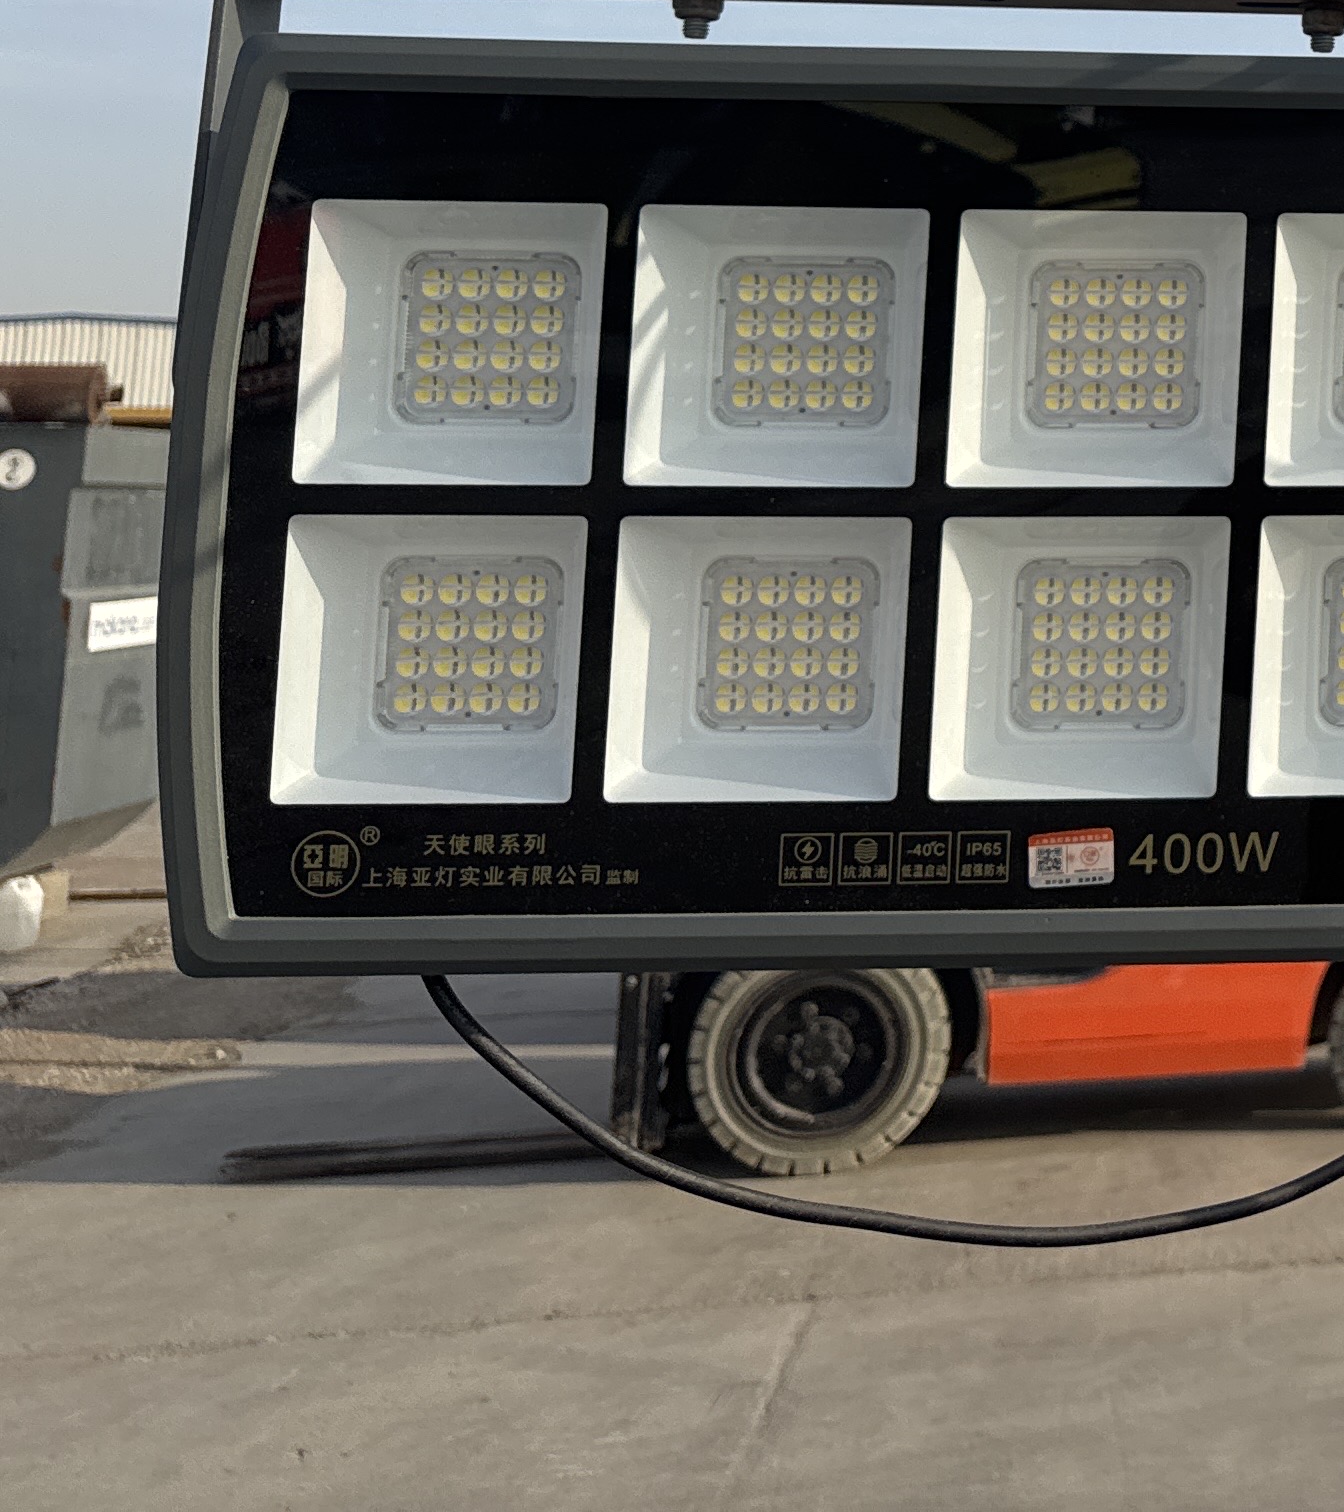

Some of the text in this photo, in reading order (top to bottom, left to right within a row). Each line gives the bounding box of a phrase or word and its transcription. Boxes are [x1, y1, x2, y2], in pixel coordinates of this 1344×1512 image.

[423, 833, 547, 855] 天使眼系列
[966, 842, 1002, 857] IP65
[1128, 831, 1280, 874] 400W
